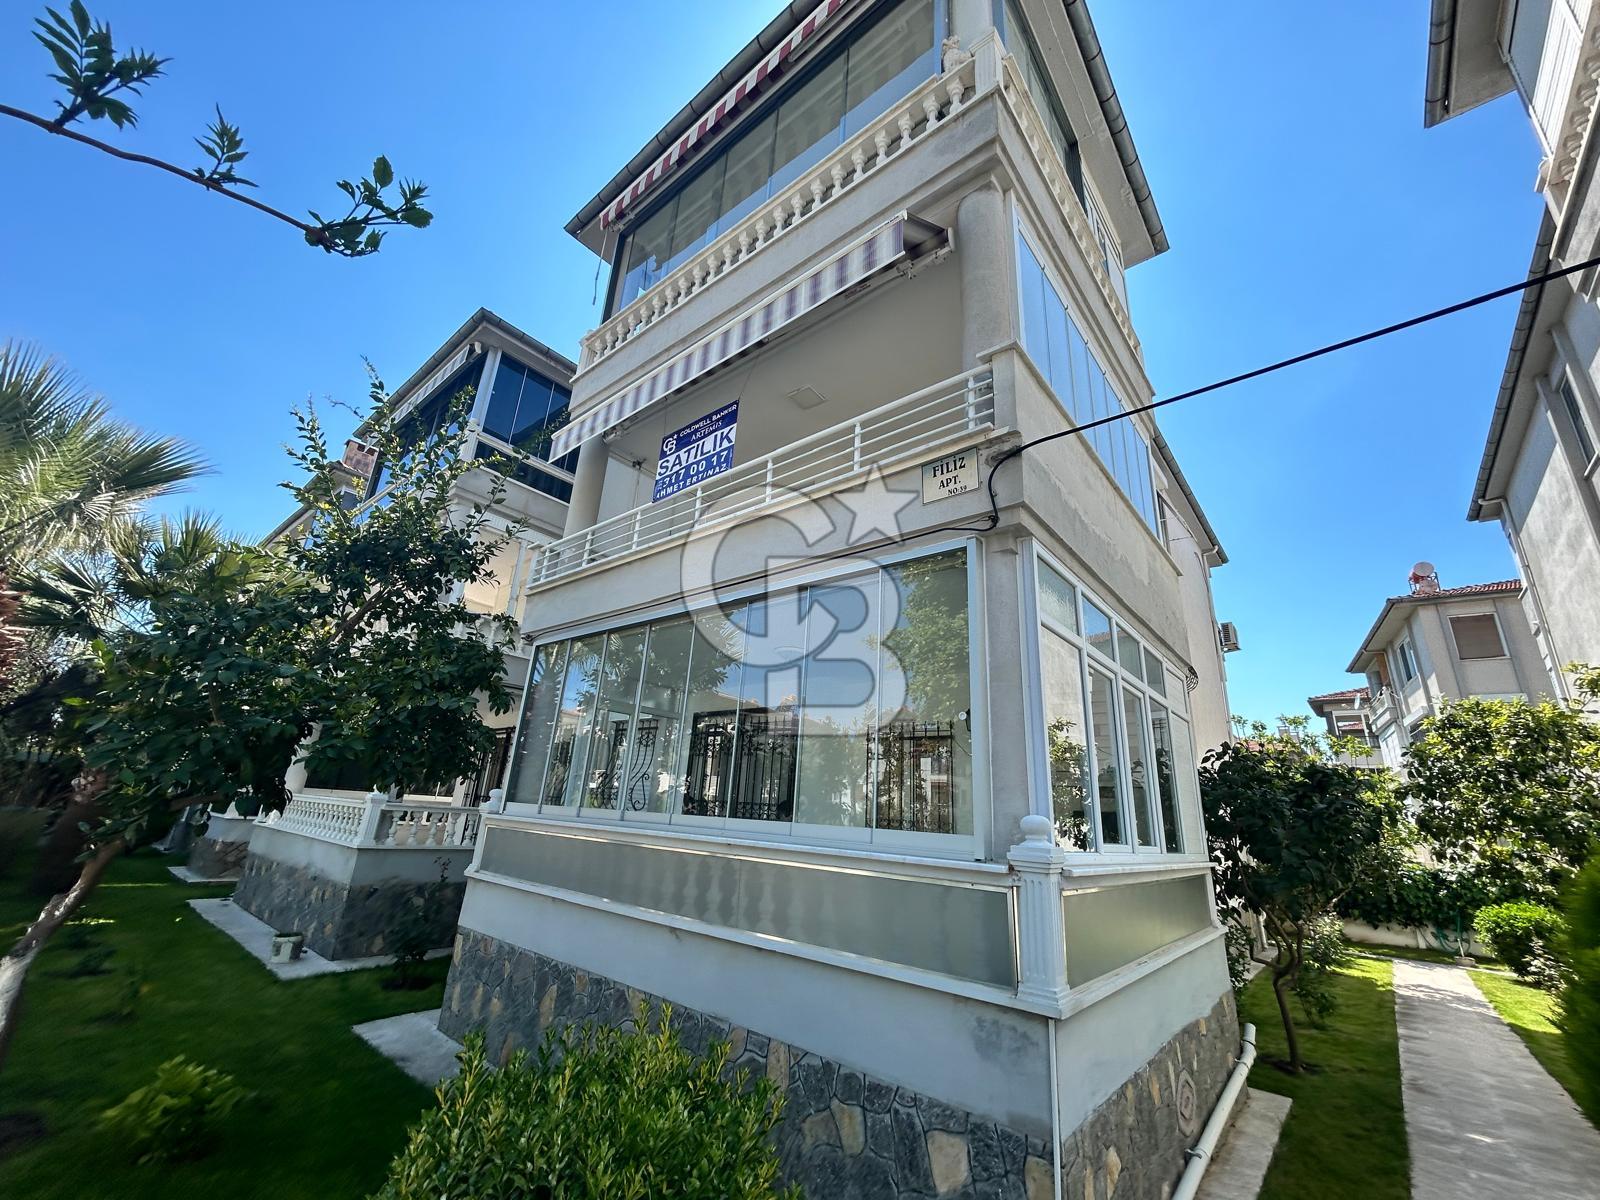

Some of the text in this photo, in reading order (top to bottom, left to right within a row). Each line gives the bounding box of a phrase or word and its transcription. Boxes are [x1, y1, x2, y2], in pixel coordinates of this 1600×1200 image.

[680, 404, 737, 437] COLDWELL BANKER
[658, 426, 735, 476] SATILIK
[932, 456, 966, 478] FİLİZ
[663, 468, 686, 488] 317
[690, 460, 706, 475] 00
[711, 451, 728, 465] 17
[938, 475, 961, 489] APT.
